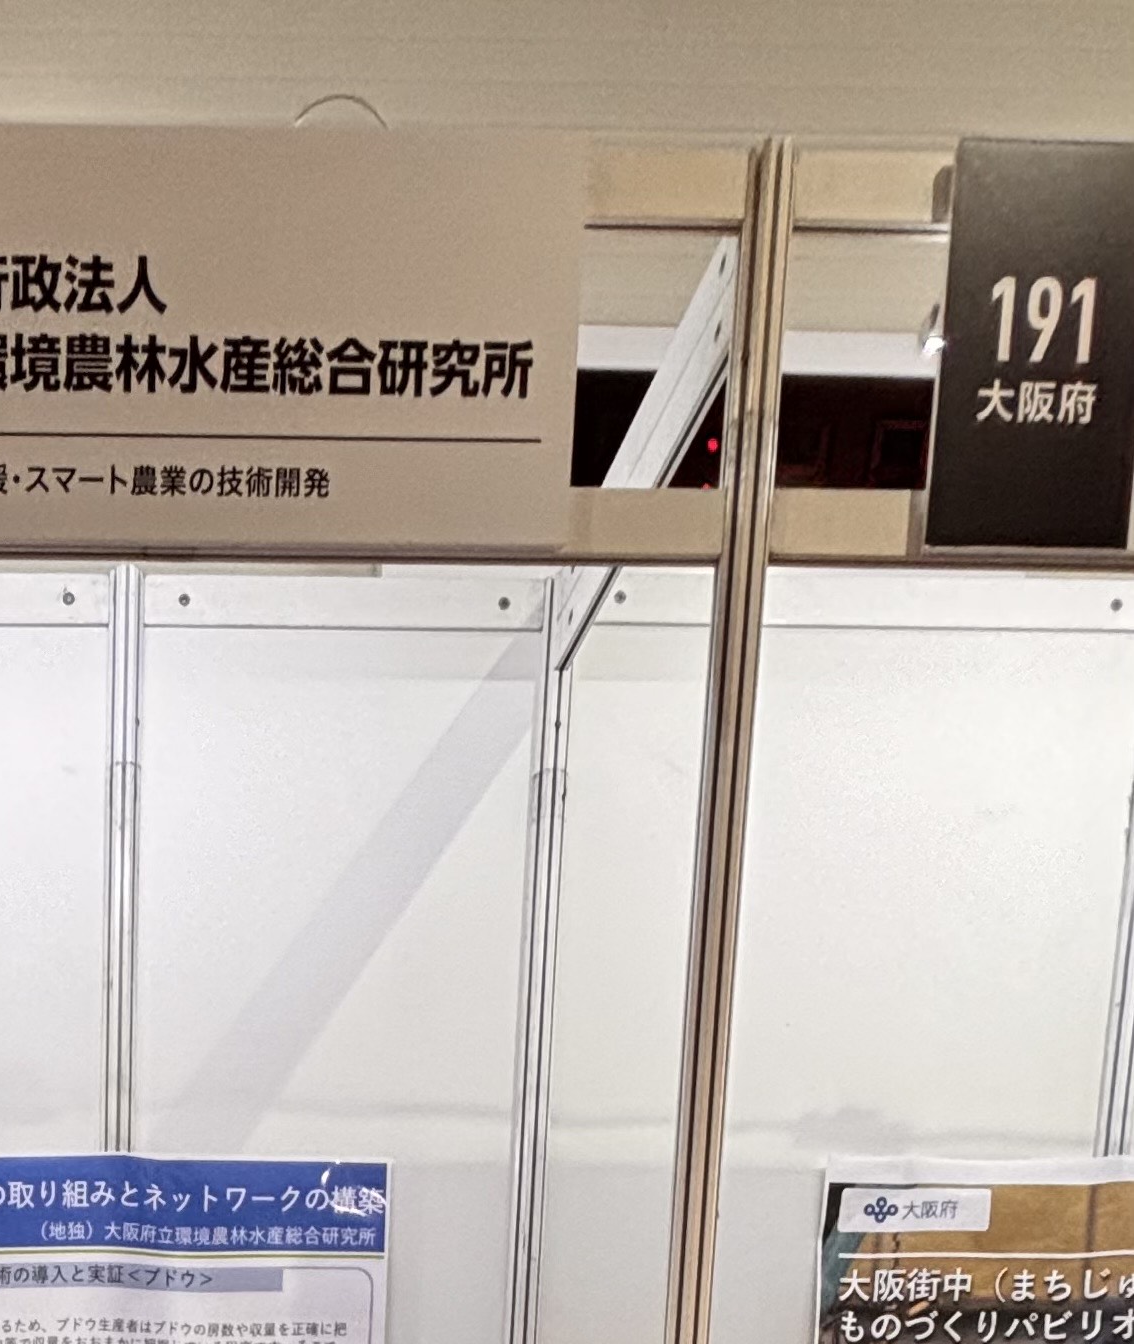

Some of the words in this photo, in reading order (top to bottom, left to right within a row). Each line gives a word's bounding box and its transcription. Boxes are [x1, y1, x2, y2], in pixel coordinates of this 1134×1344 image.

[991, 275, 1099, 365] 191
[975, 381, 1098, 425] 大阪府
[901, 1200, 958, 1219] 大阪府
